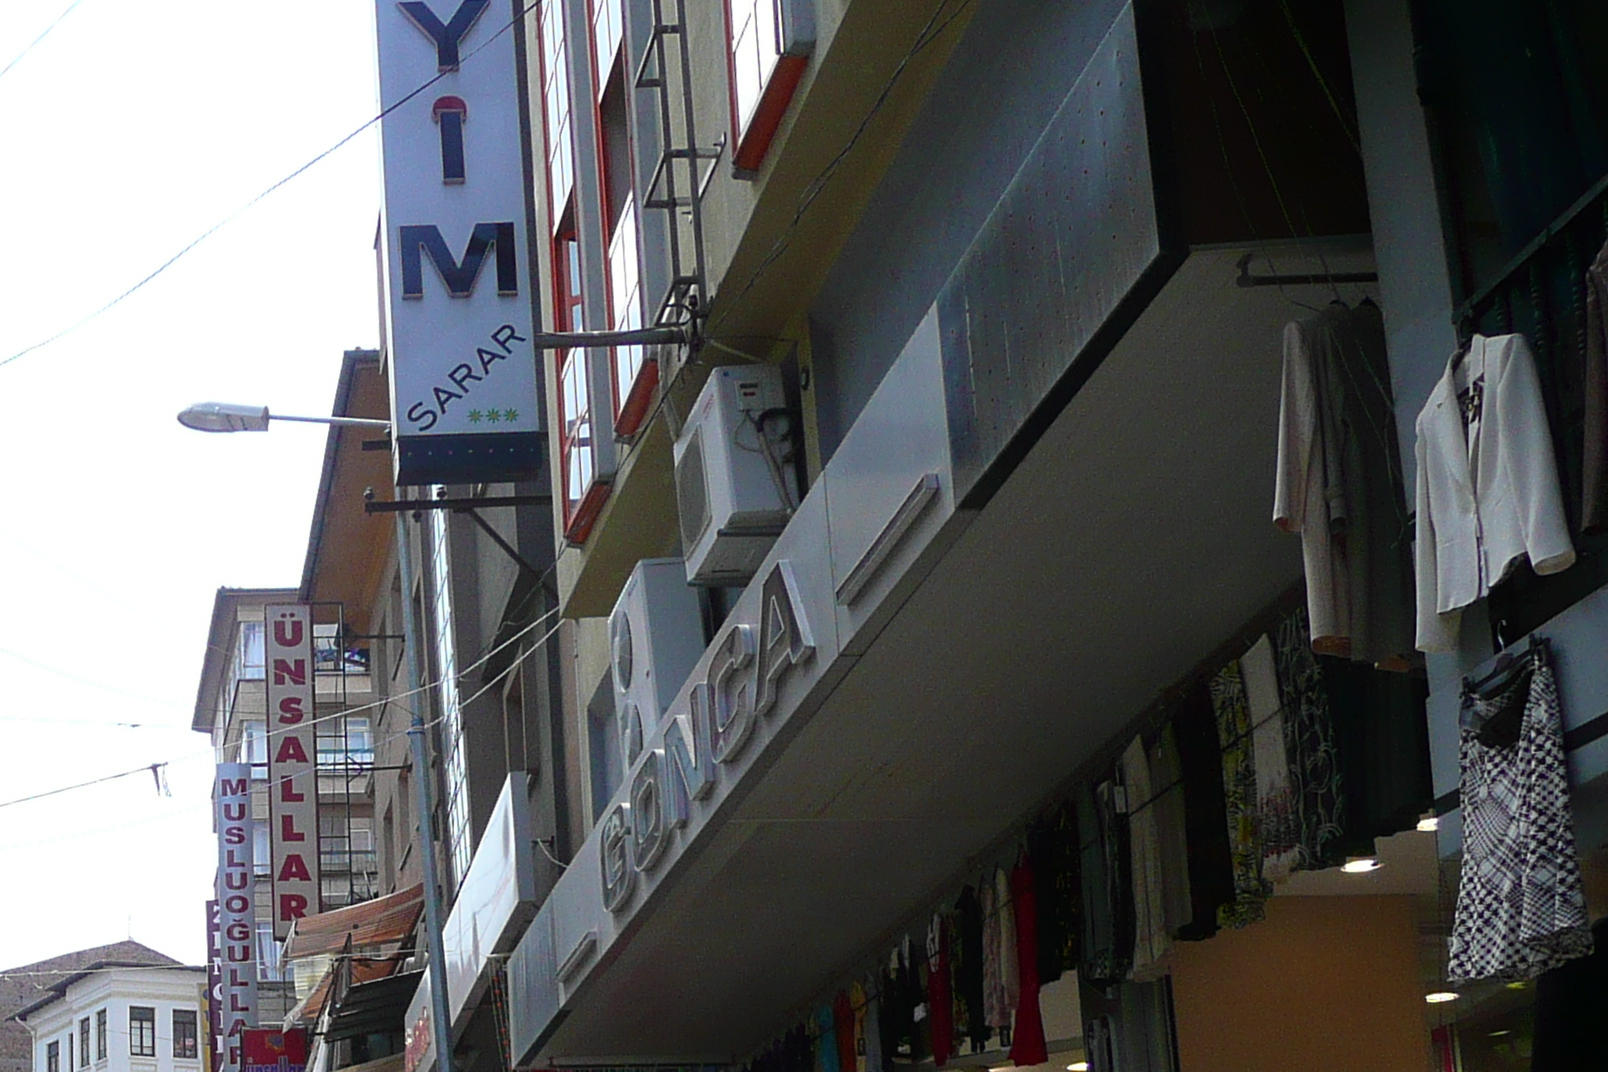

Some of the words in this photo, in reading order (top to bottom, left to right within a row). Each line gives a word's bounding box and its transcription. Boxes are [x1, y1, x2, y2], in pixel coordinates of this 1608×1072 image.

[407, 323, 527, 432] SARAR
[272, 612, 312, 922] ÜNSALLAR
[600, 559, 816, 914] GONCA
